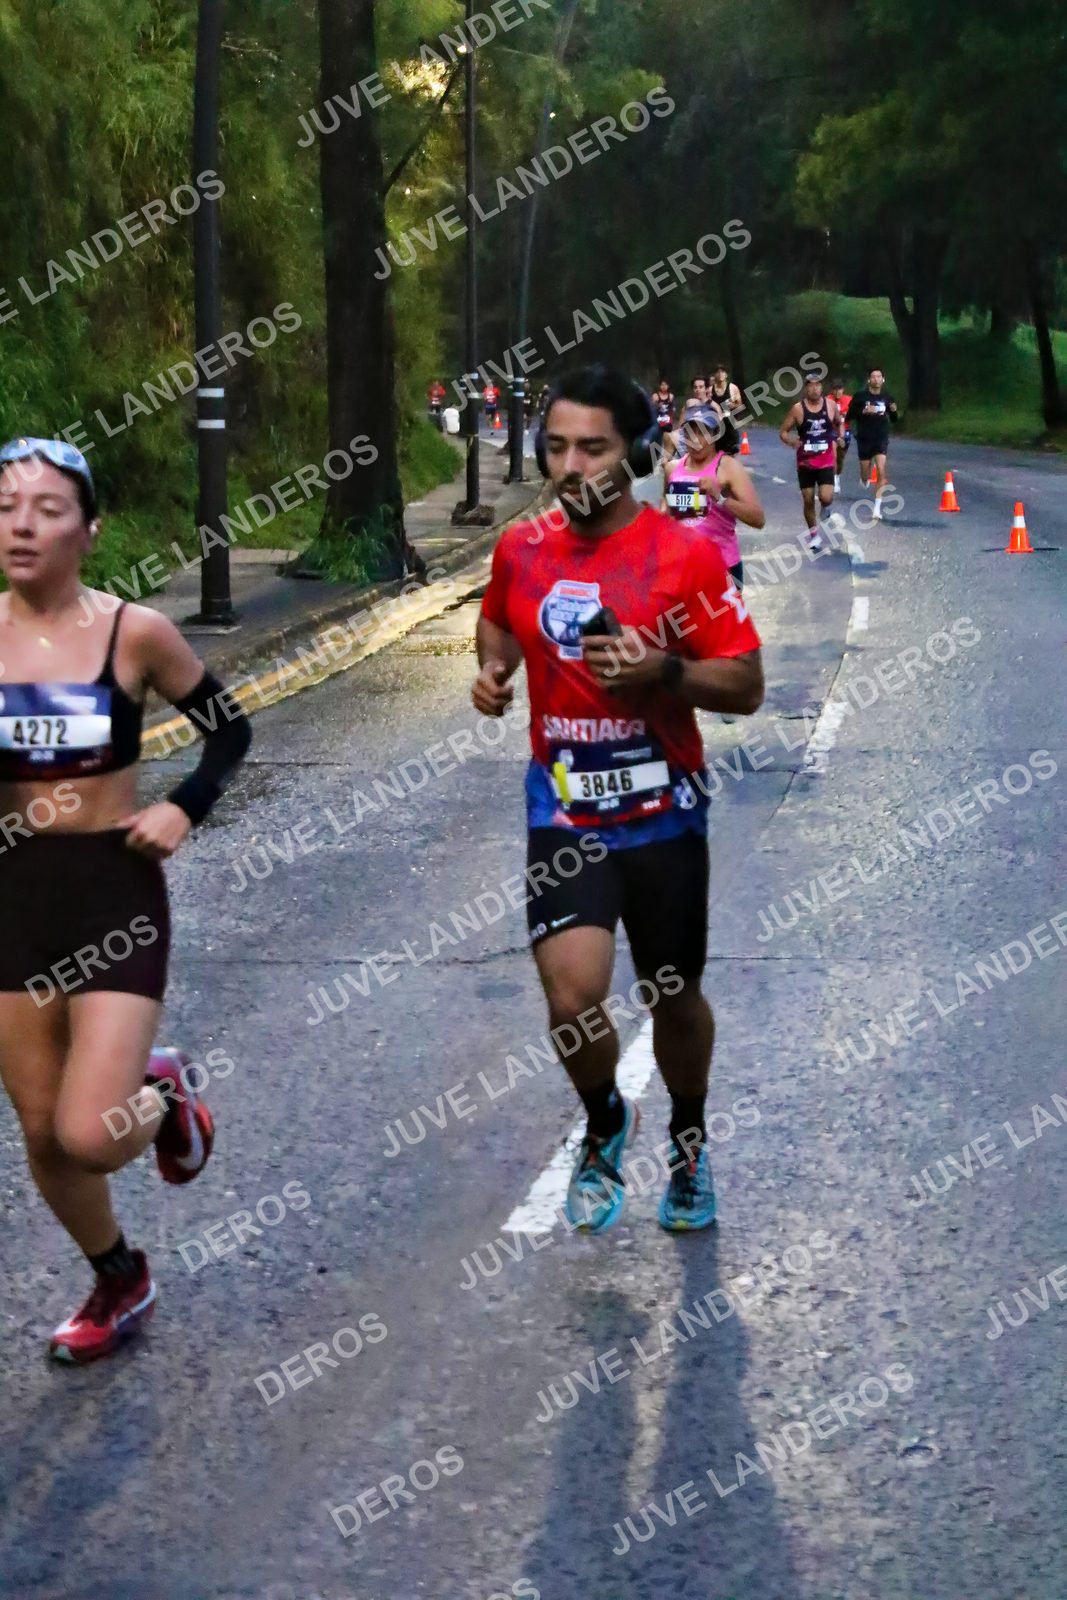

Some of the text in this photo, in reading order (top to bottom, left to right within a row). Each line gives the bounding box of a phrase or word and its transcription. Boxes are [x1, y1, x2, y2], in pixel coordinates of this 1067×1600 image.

[675, 495, 692, 506] 5112
[12, 718, 68, 745] 4272
[580, 768, 633, 798] 3846
